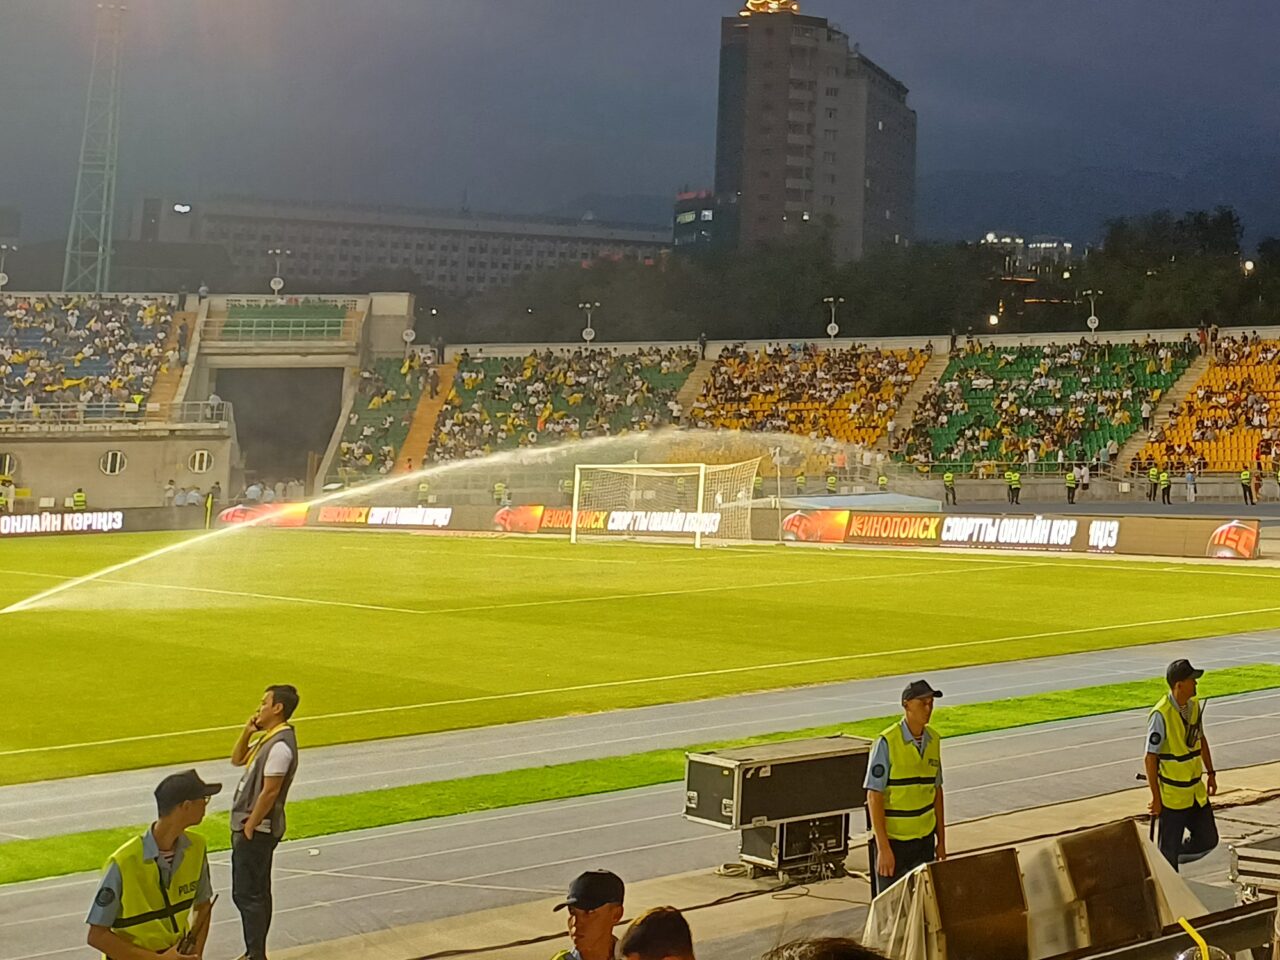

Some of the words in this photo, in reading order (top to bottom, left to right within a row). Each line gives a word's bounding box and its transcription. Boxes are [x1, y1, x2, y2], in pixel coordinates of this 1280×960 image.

[0, 512, 61, 534] ОНЛАЙН
[63, 511, 123, 531] КӨРІҢІЗ
[541, 509, 608, 529] КИНООИСК
[849, 515, 940, 539] КИНОПОИСК
